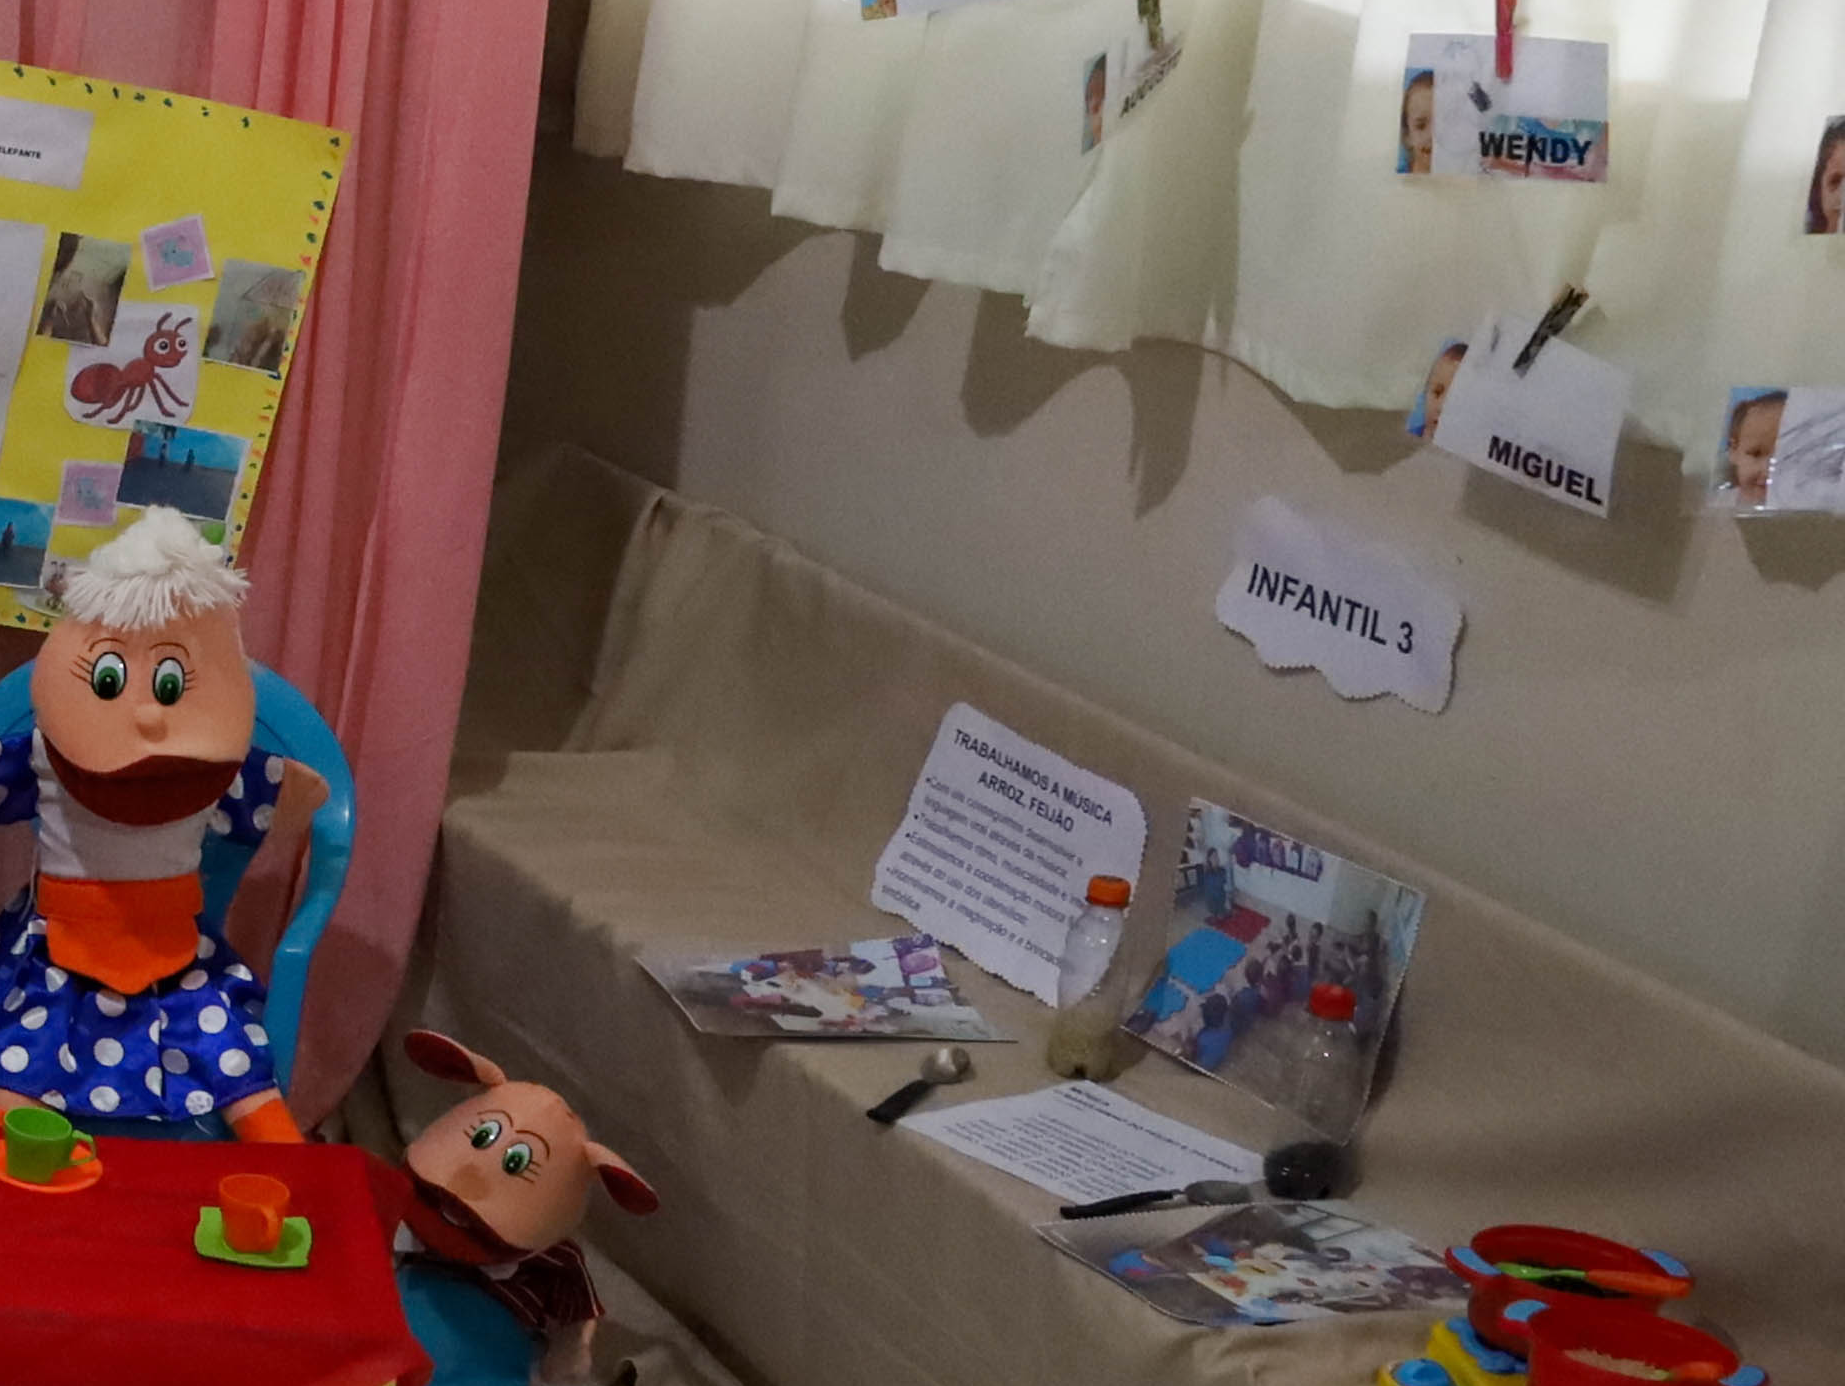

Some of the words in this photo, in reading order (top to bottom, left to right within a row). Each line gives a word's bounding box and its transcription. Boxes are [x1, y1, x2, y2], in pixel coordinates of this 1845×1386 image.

[1479, 131, 1593, 166] WENDY
[1487, 436, 1604, 507] MIGUEL
[1247, 564, 1388, 647] INFANTIL
[1397, 622, 1414, 655] 3
[954, 729, 1049, 791] TRABALHAMOS
[1050, 783, 1060, 798] A
[1063, 786, 1113, 826] MÚSICA
[1029, 797, 1074, 833] FEIJÃO
